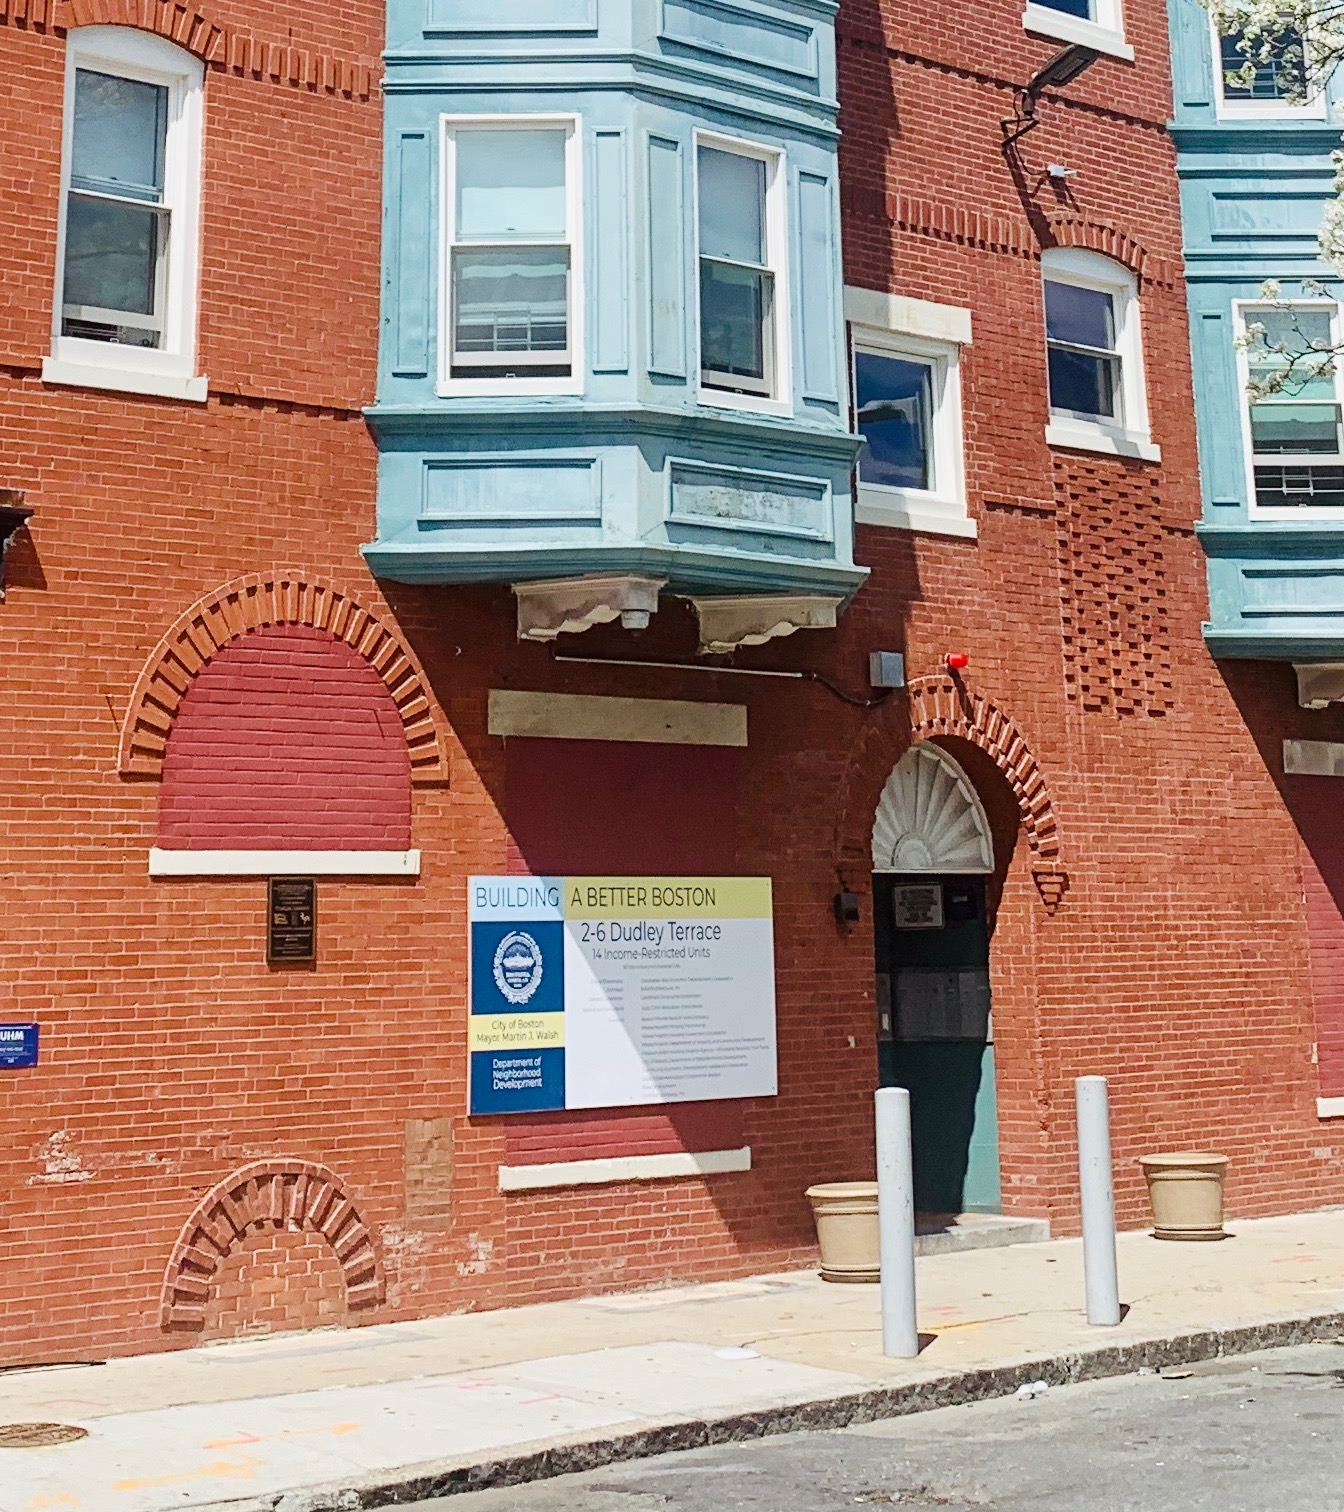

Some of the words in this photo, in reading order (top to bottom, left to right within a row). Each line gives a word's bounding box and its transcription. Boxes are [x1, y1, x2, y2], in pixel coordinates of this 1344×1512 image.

[476, 887, 559, 907] BUILDING
[571, 887, 583, 907] A
[587, 887, 647, 907] BETTER
[652, 887, 716, 907] BOSTON
[581, 922, 606, 942] 2-6
[610, 921, 664, 946] Dudley
[667, 921, 721, 942] Terrace
[592, 948, 602, 960] 14
[604, 947, 686, 961] Income-Restricted
[688, 947, 710, 958] Units
[491, 1020, 506, 1031] City
[508, 1019, 516, 1029] of
[518, 1019, 544, 1029] Boston
[0, 1030, 24, 1041] UHM
[476, 1033, 500, 1044] Mayor
[502, 1032, 527, 1042] Martin
[536, 1030, 559, 1040] Walsh
[492, 1058, 533, 1071] Department
[533, 1055, 542, 1066] of
[492, 1068, 542, 1081] Neighborhood
[493, 1078, 543, 1090] Development
